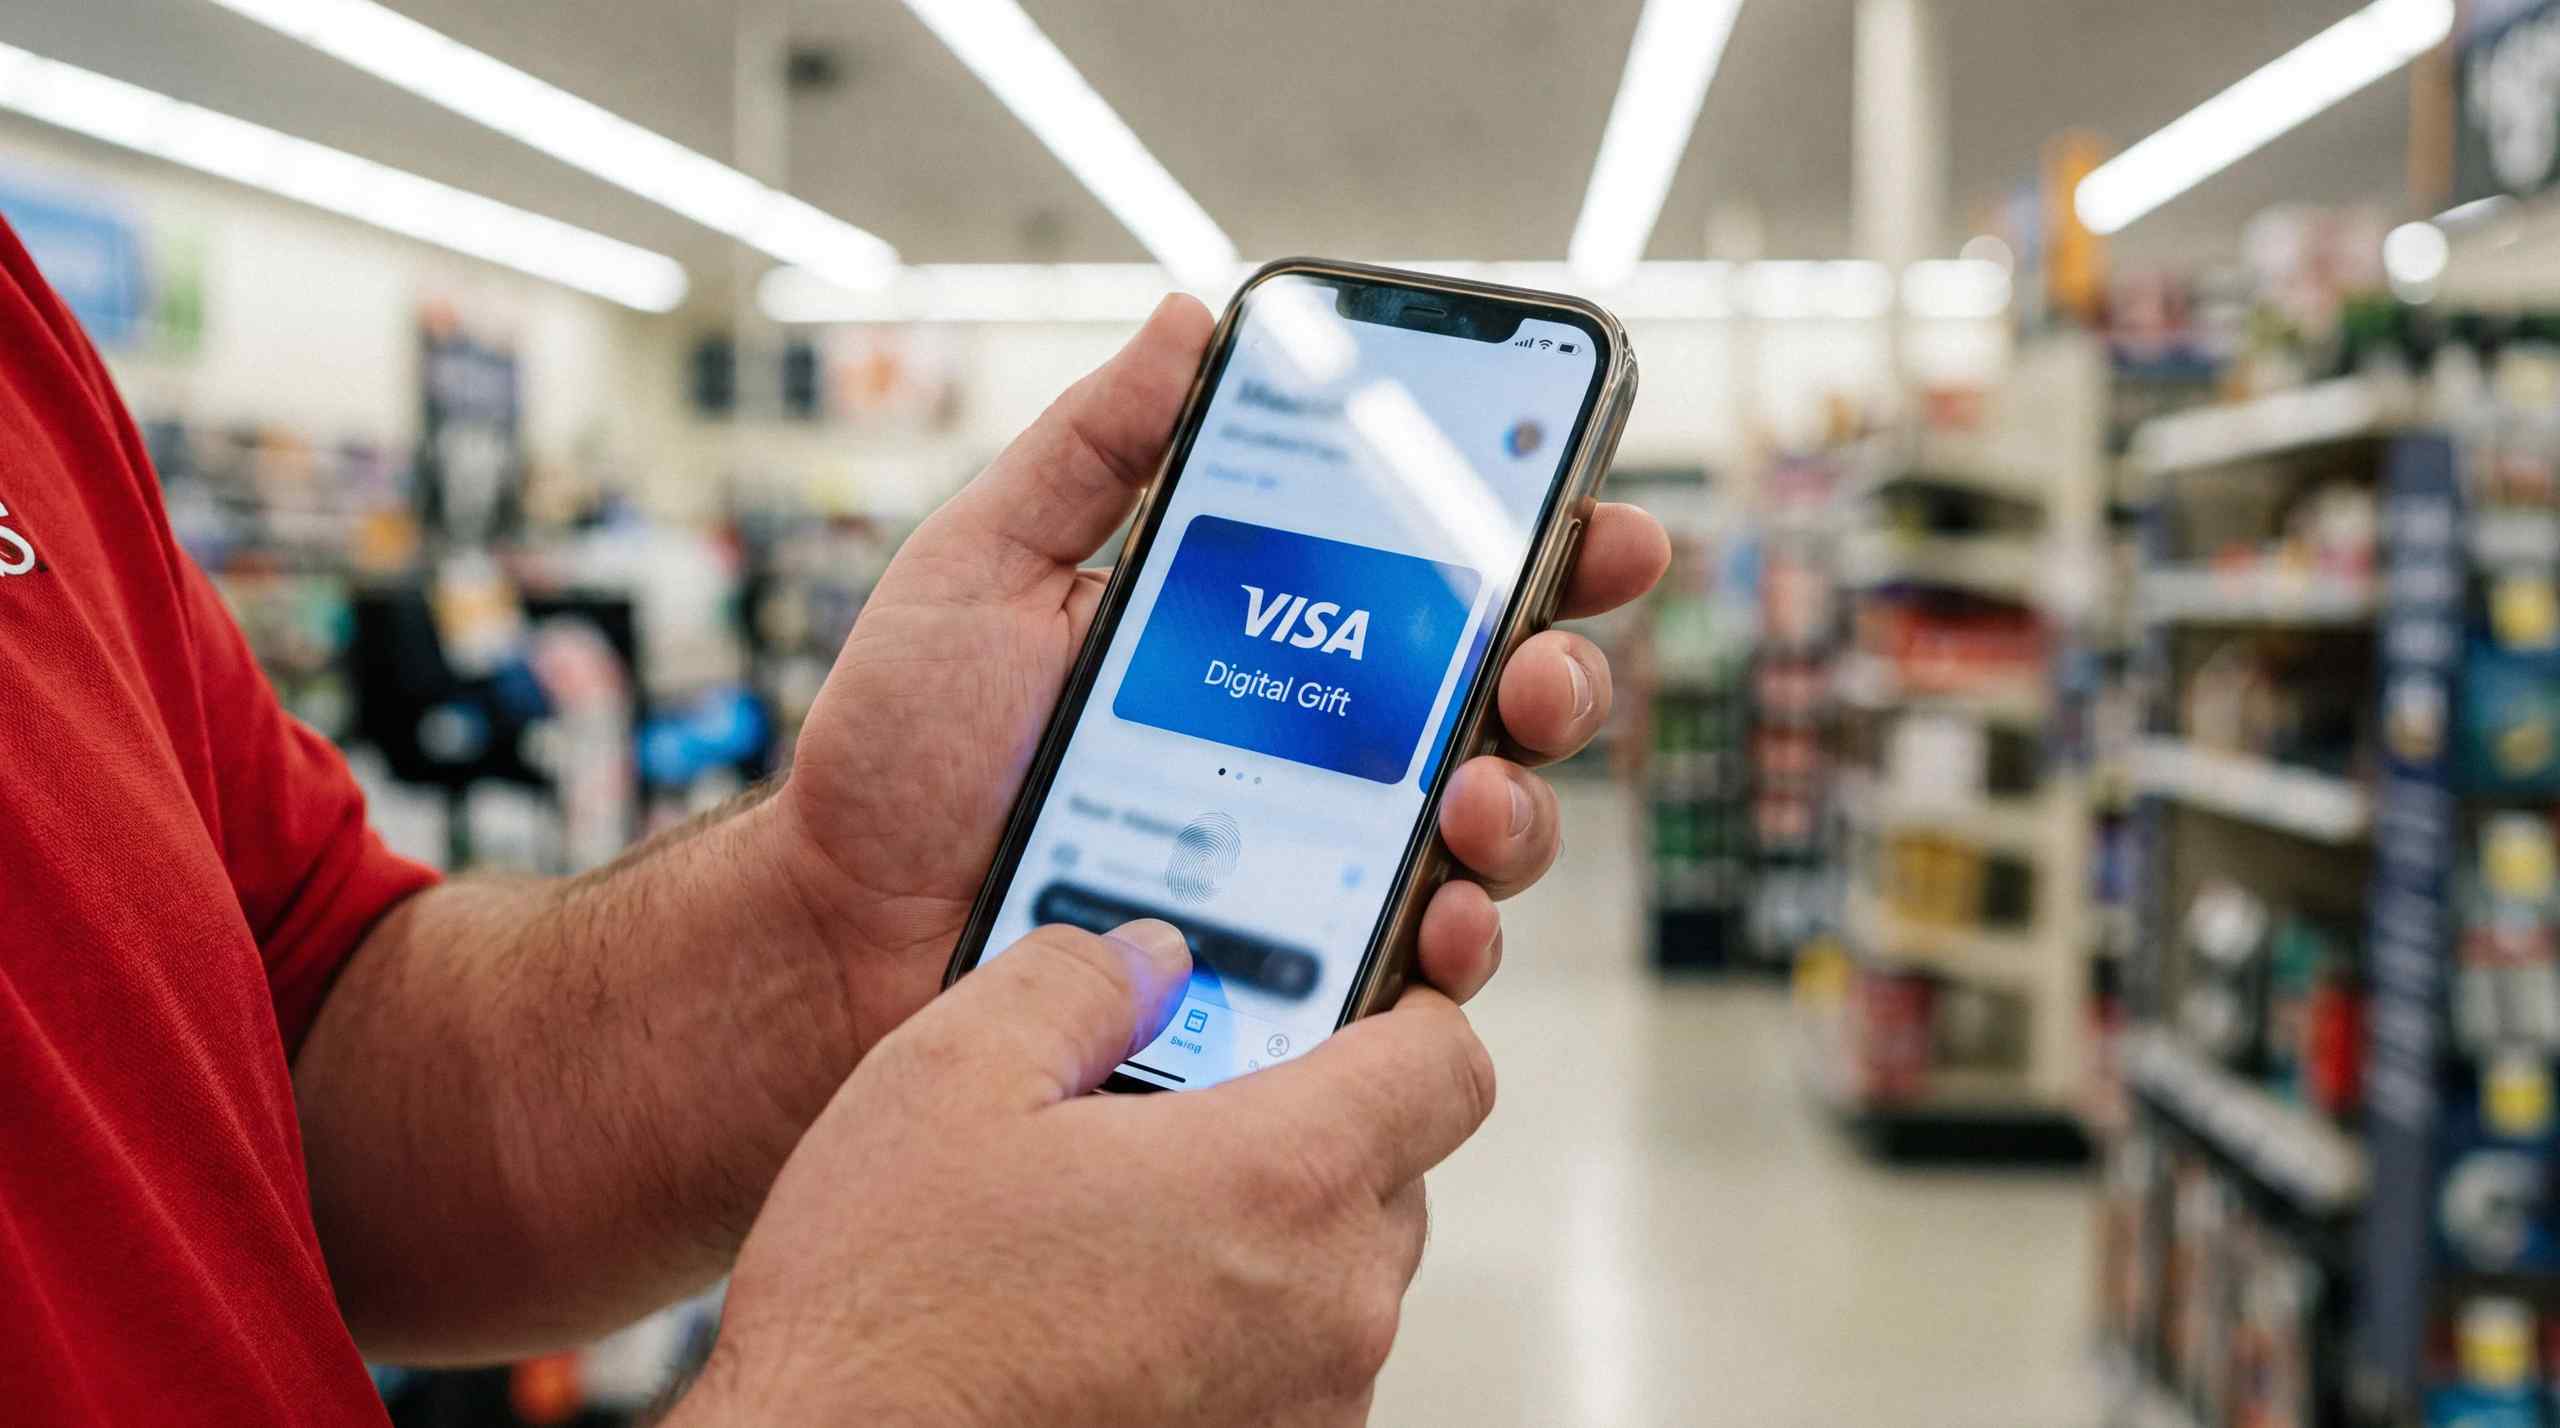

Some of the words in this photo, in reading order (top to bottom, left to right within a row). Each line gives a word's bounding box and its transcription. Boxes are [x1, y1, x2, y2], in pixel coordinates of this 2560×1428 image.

[1241, 584, 1370, 661] VISA
[1204, 660, 1294, 702] Digital
[1298, 682, 1351, 717] Gift
